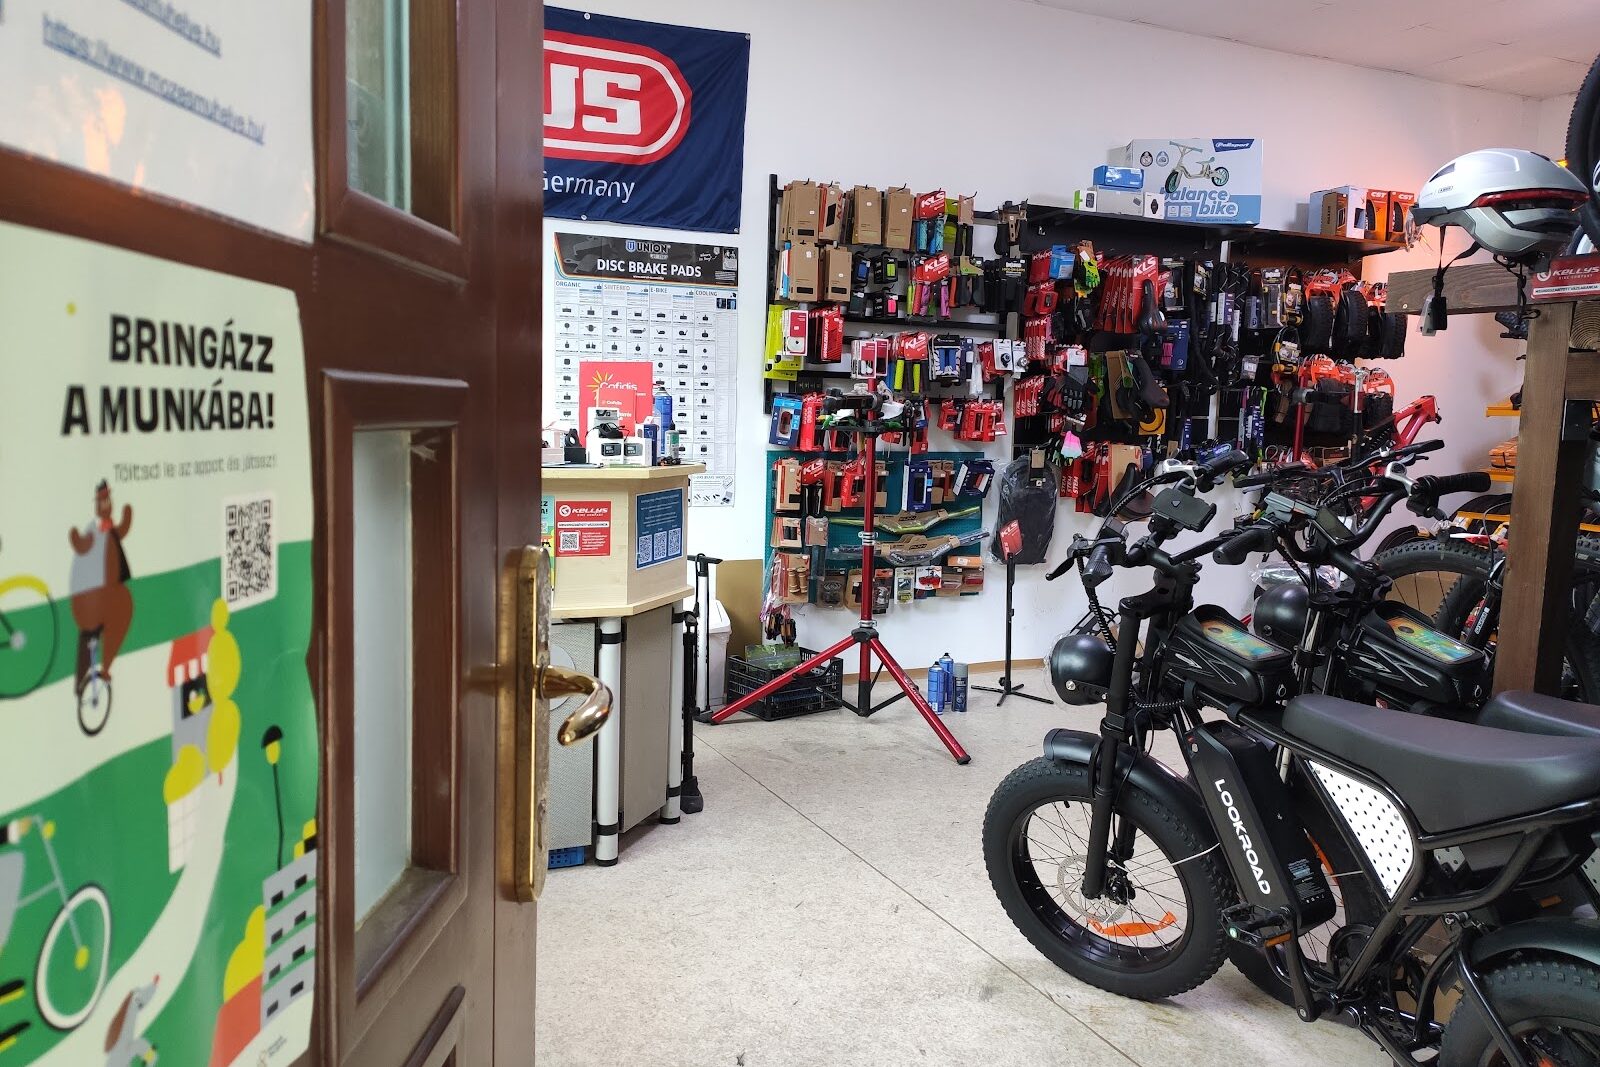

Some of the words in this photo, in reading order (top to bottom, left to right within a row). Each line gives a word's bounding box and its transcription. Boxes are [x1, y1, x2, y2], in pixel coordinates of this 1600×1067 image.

[921, 191, 945, 208] KLS
[1199, 201, 1237, 215] bike
[637, 242, 669, 254] UNION
[597, 258, 625, 272] DISC
[628, 261, 668, 276] BRAKE
[671, 264, 702, 278] PADS
[925, 254, 948, 272] KLS
[1134, 257, 1156, 277] KLS
[1552, 266, 1600, 277] KELLYS
[109, 314, 274, 373] BRINGÁZZ
[906, 333, 927, 349] KLS
[600, 382, 637, 391] Cofidis
[61, 385, 91, 436] A
[100, 378, 274, 434] MUNKÁBA!
[162, 462, 176, 478] le
[803, 459, 823, 475] KLS
[1001, 521, 1018, 538] KLS
[1214, 778, 1271, 895] LOOKROAD
